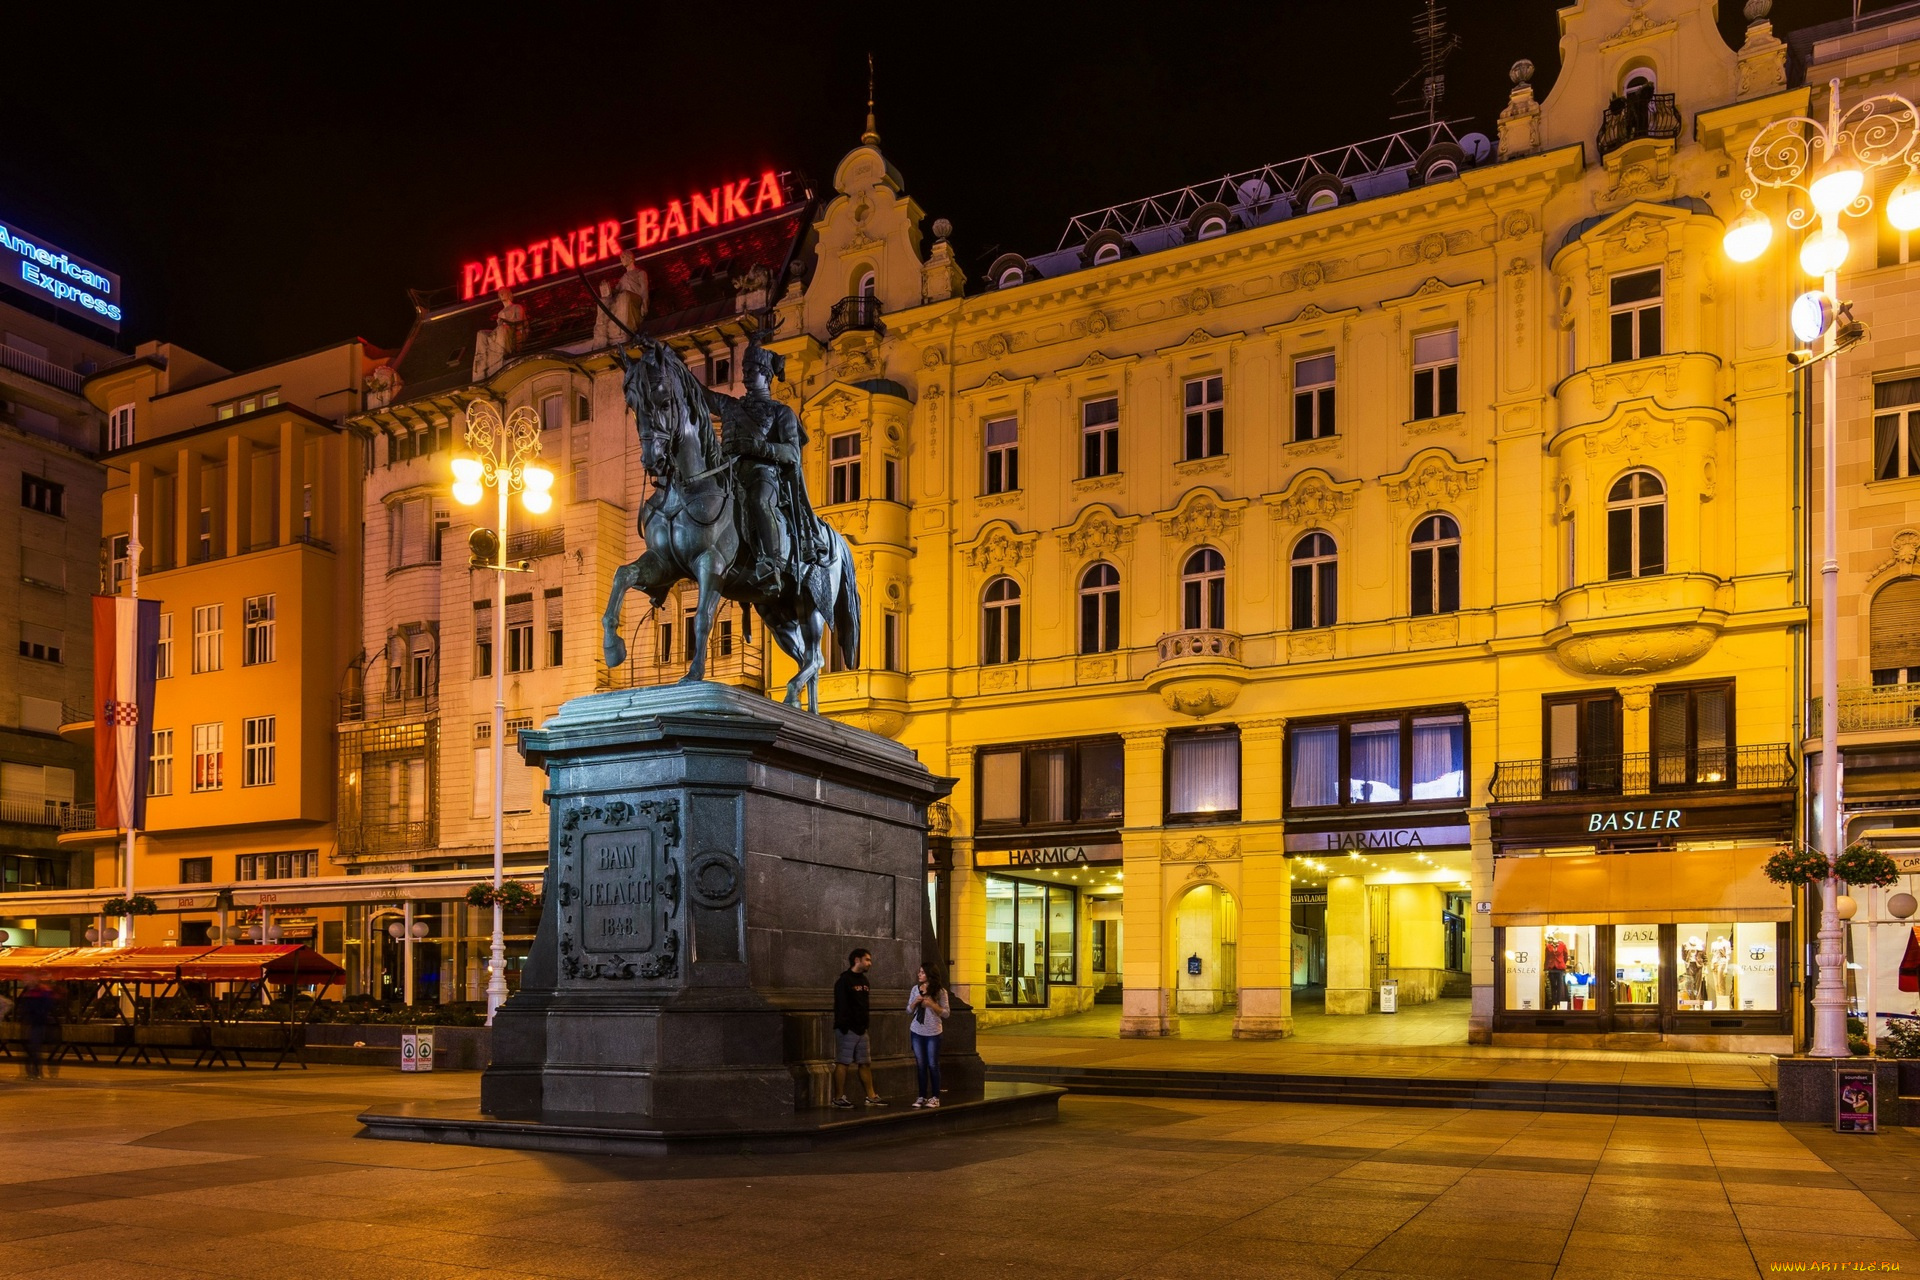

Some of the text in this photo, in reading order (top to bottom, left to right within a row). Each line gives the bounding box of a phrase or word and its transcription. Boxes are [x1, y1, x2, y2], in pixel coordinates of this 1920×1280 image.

[463, 170, 784, 301] PARTNER BANKA
[0, 225, 110, 294] American
[22, 260, 121, 321] Express
[1588, 809, 1681, 832] BASLER
[1326, 830, 1424, 850] HARMICA
[598, 845, 636, 870] BAN
[1008, 846, 1088, 865] HARMICA
[1622, 930, 1659, 941] BASL
